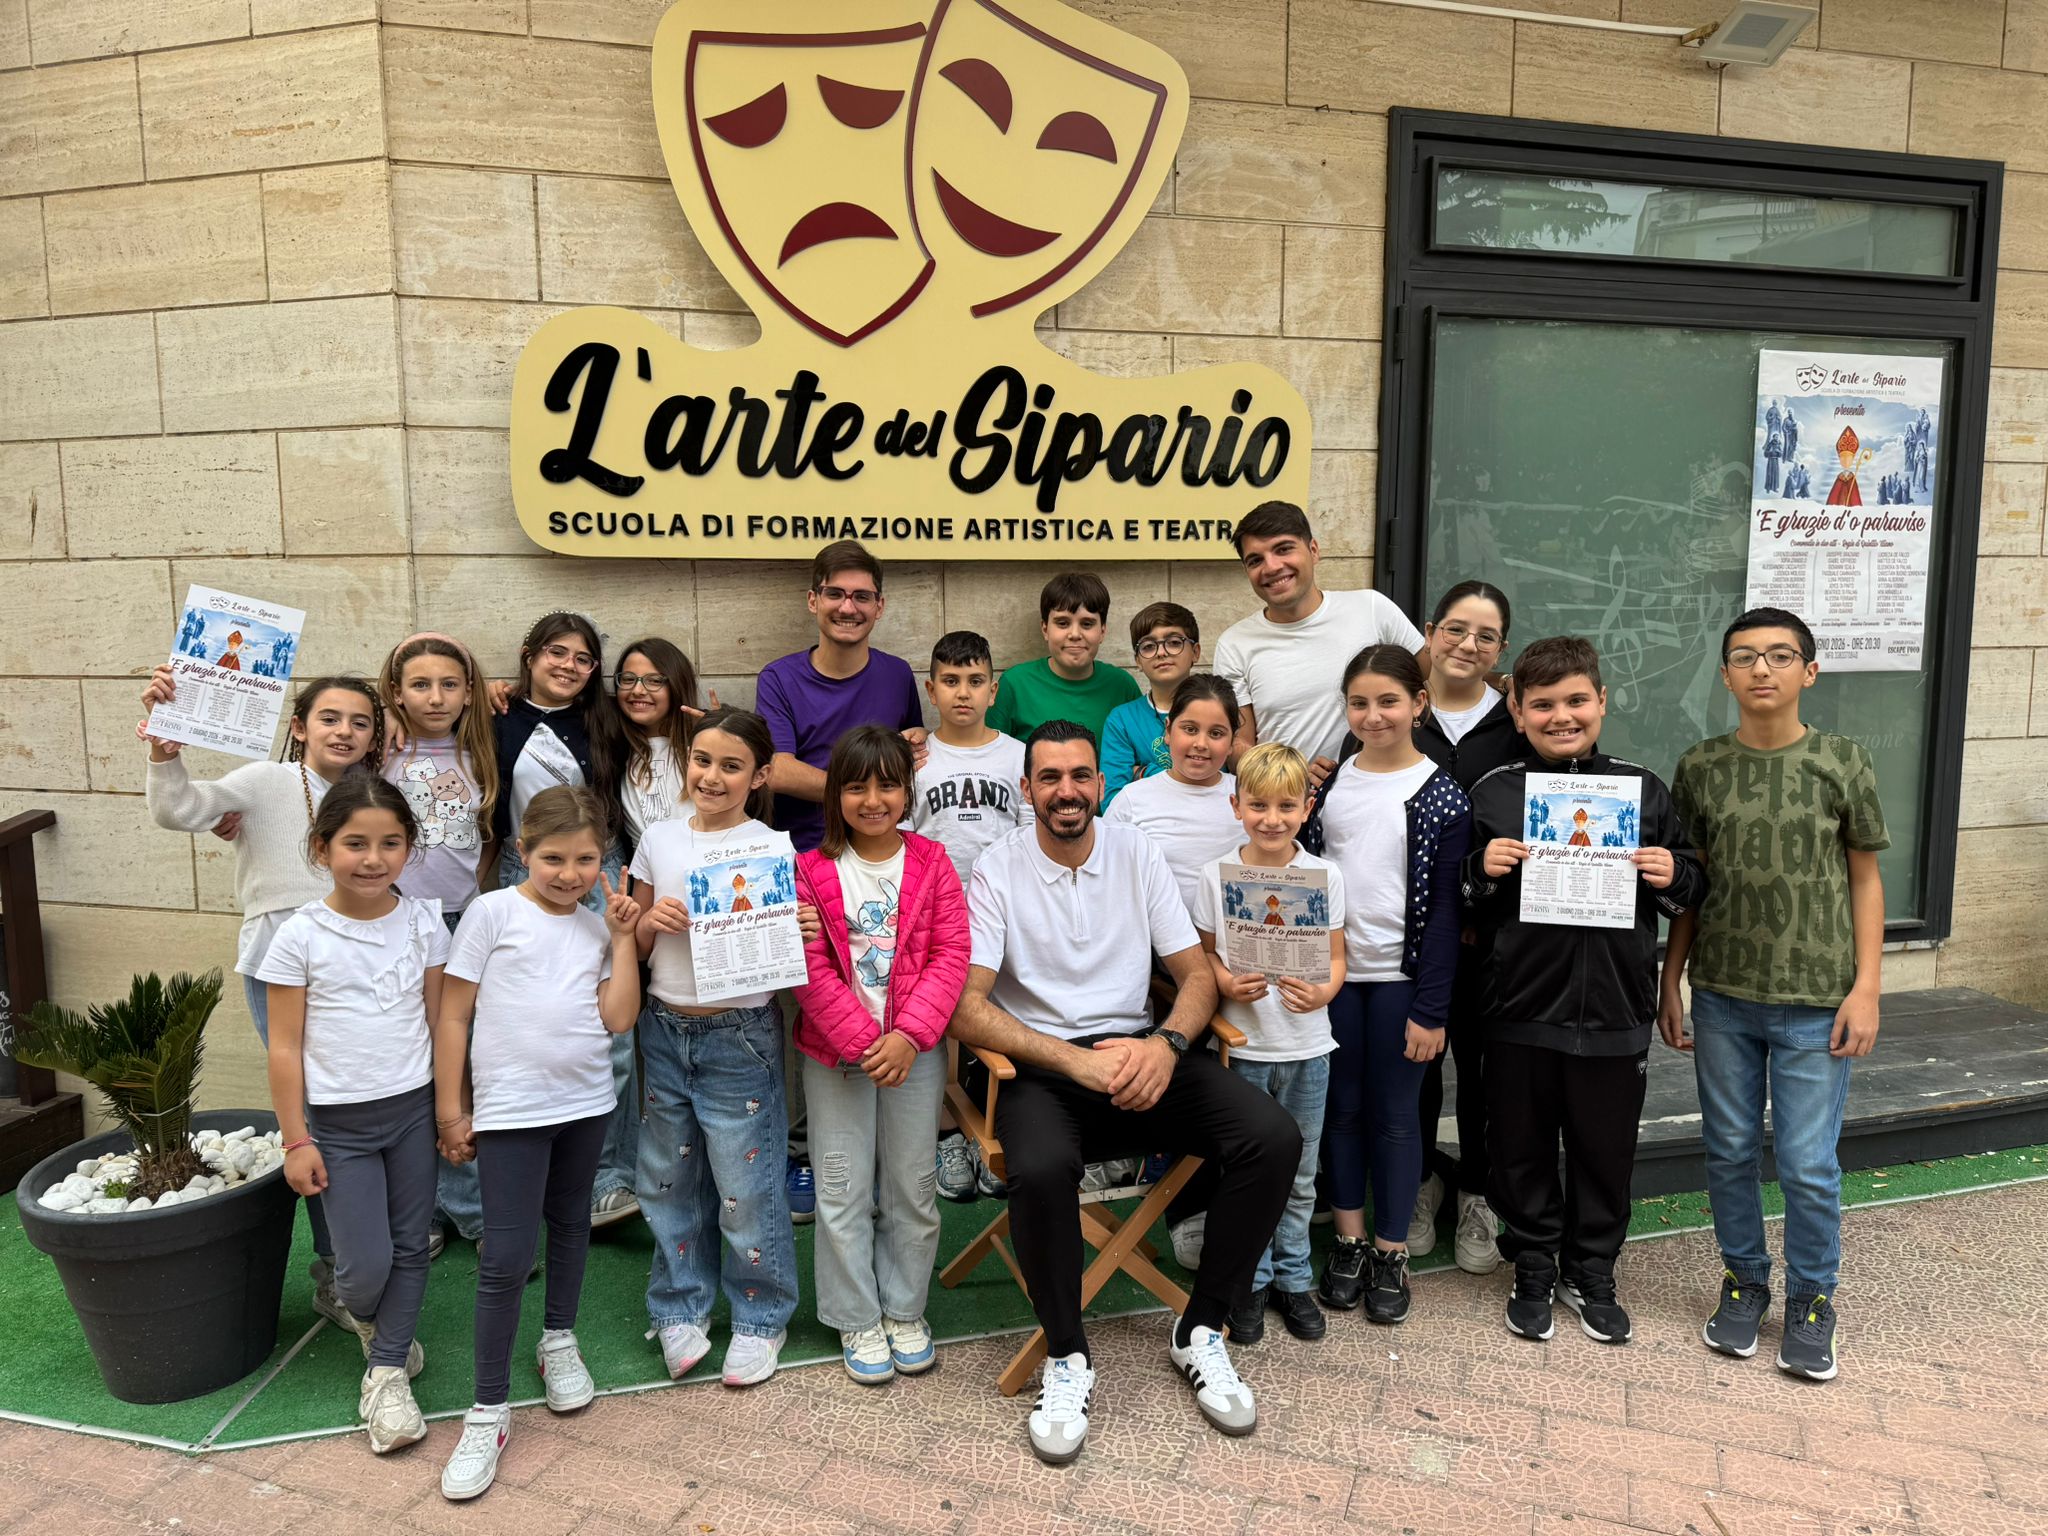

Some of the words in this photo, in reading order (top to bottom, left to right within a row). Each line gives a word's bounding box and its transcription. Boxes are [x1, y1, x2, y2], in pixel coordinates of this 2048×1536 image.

[1872, 371, 1907, 388] Sipario
[540, 342, 866, 498] L'arte
[873, 408, 947, 458] del
[948, 365, 1291, 513] Sipario
[548, 510, 691, 538] SCUOLA
[702, 514, 734, 538] DI
[747, 514, 954, 541] FORMAZIONE
[964, 517, 1114, 541] ARTISTICA
[1124, 519, 1139, 541] E
[1148, 519, 1233, 541] TEATR
[1774, 509, 1831, 539] grazie
[1860, 510, 1926, 538] paravise
[1831, 638, 1846, 650] 2026
[1851, 638, 1863, 650] ORE
[179, 660, 218, 678] grazie
[237, 676, 284, 693] paravise
[926, 777, 1010, 816] BRAND
[1537, 846, 1570, 863] grazie
[703, 915, 735, 935] grazie
[754, 905, 796, 925] paravise
[1237, 922, 1267, 937] grazie
[1285, 926, 1328, 939] paravise
